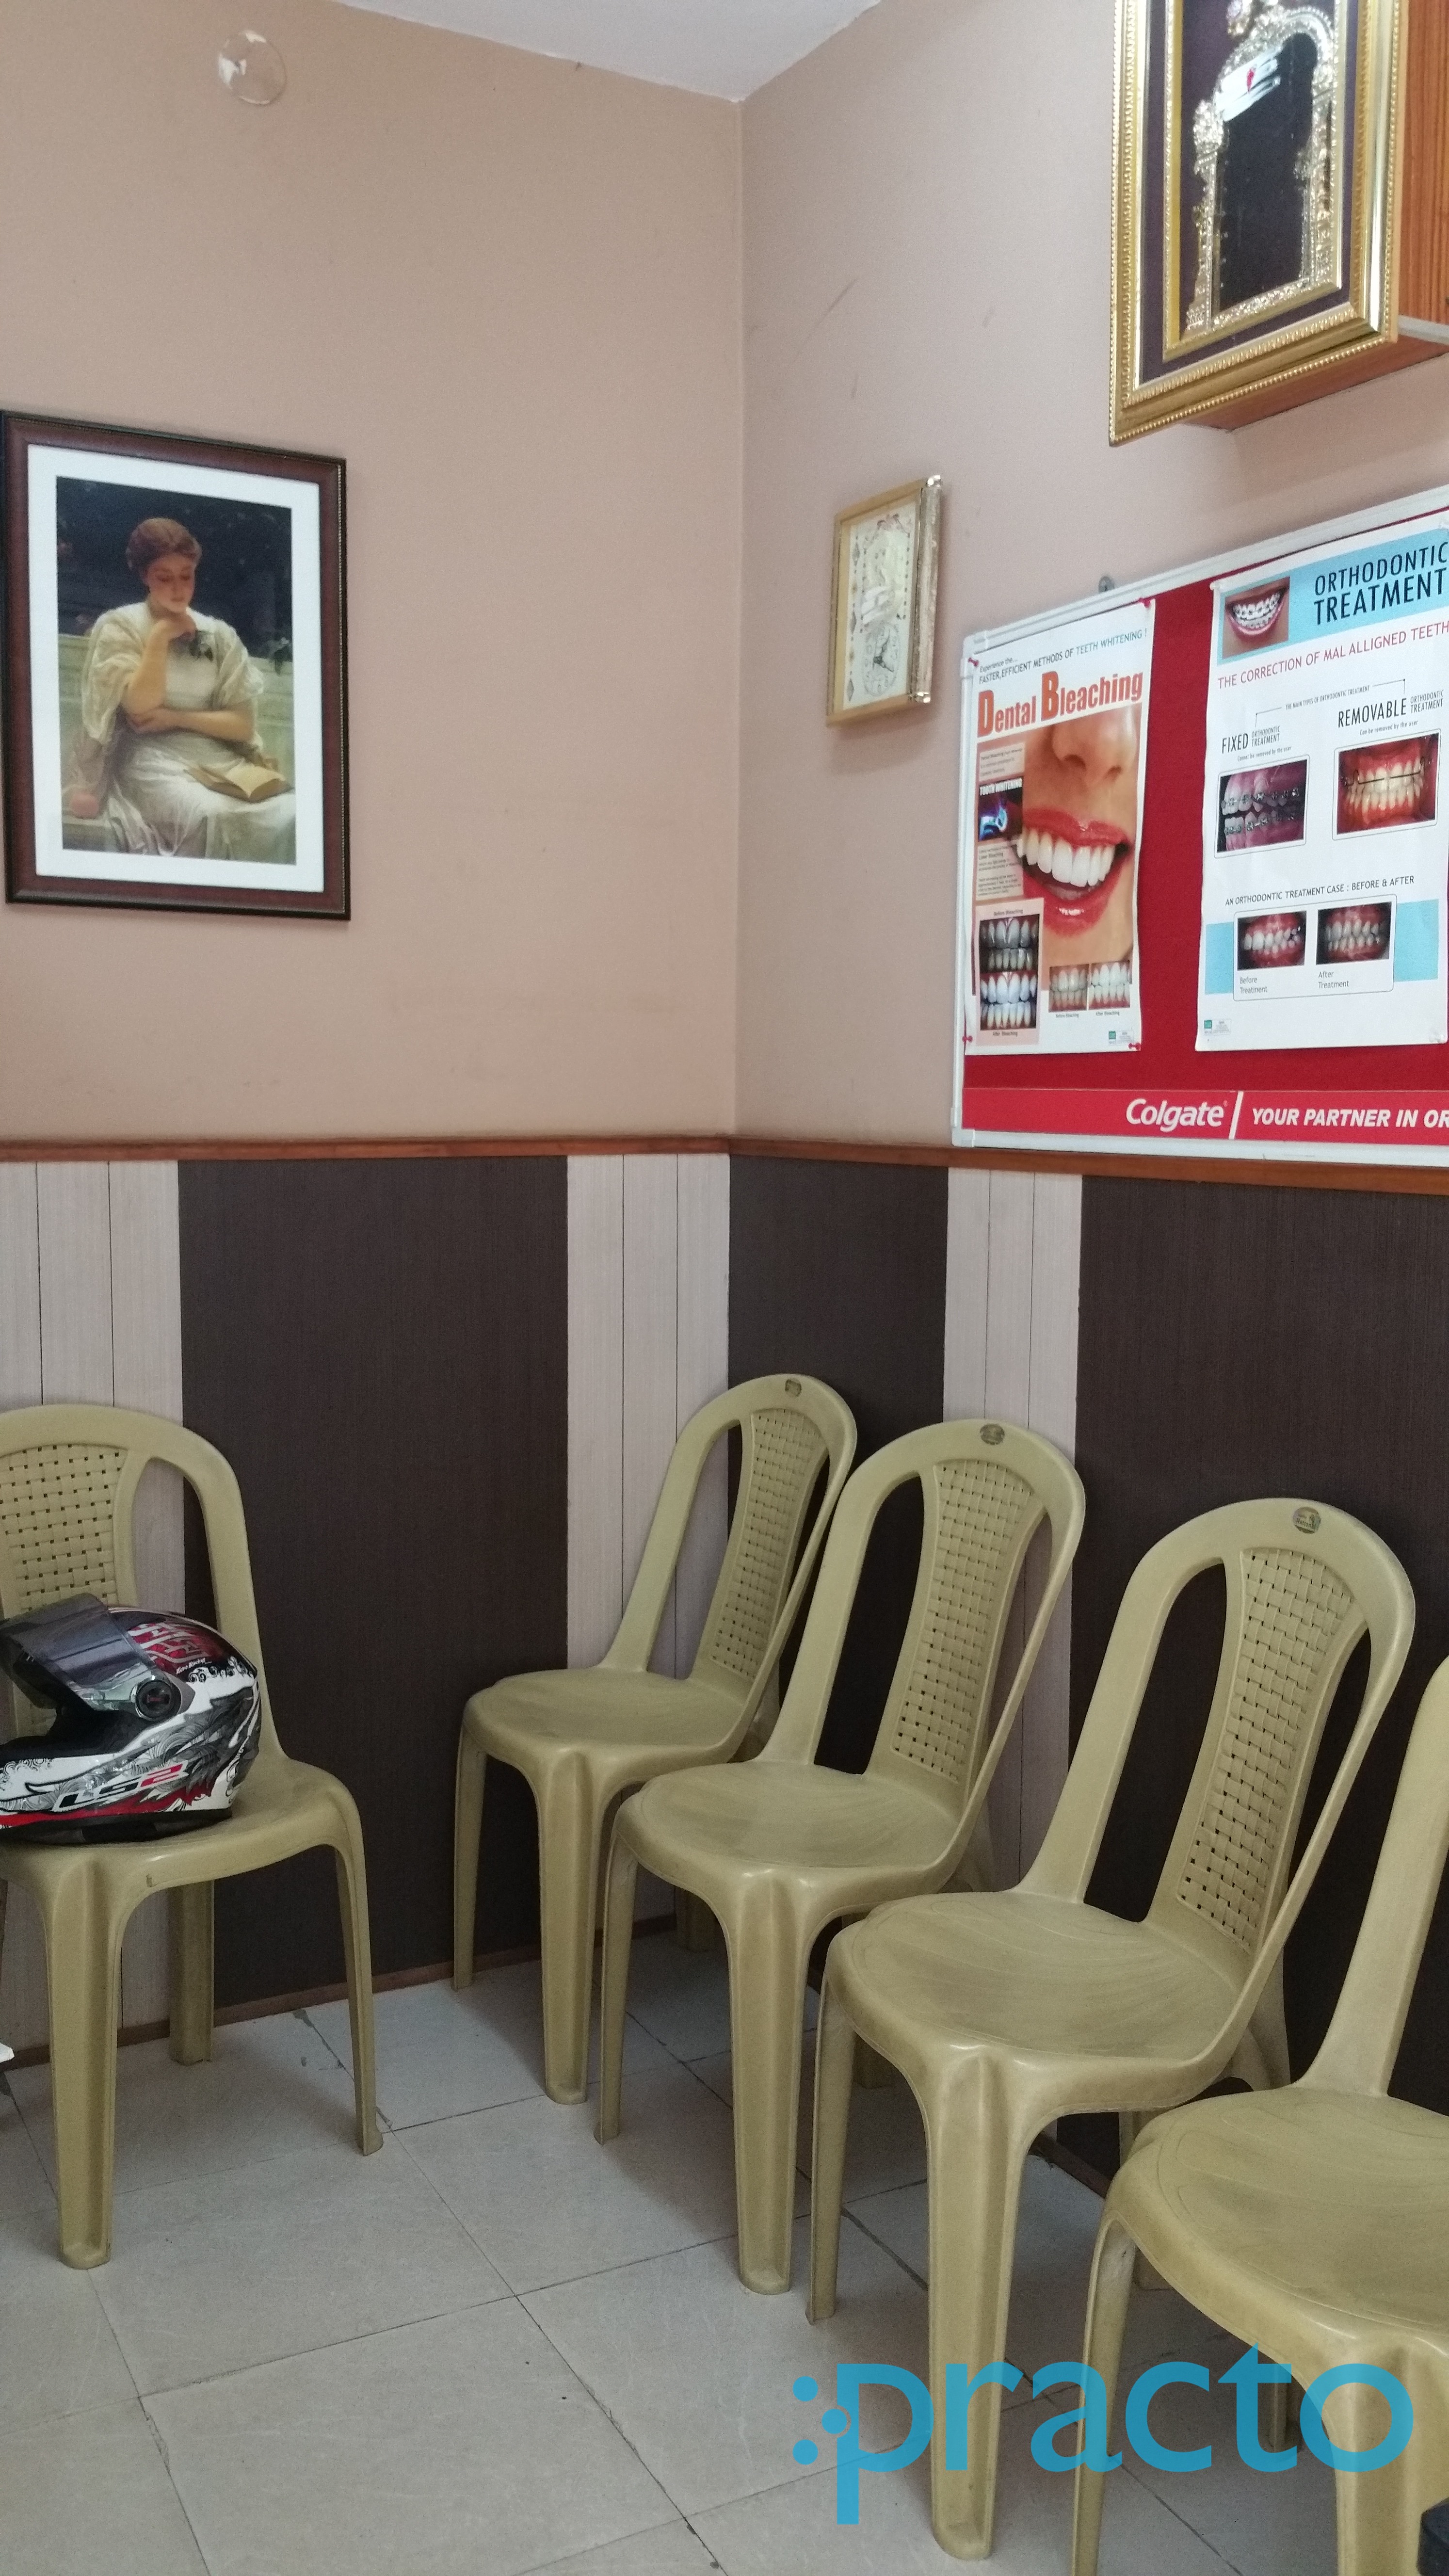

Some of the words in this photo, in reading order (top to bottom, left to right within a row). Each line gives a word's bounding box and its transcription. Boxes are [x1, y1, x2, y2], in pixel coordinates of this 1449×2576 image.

[1315, 541, 1449, 596] ORTHODONTIC
[1314, 567, 1447, 625] TREATMENT
[1033, 651, 1063, 667] METHODS
[1064, 648, 1074, 659] OF
[1076, 641, 1098, 655] TEETH
[1100, 629, 1142, 648] WHITENING
[1218, 674, 1237, 689] THE
[1240, 656, 1302, 684] CORRECTION
[1306, 651, 1320, 666] OF
[1323, 645, 1346, 661] MAL
[1349, 631, 1406, 655] ALLIGNED
[1410, 620, 1449, 641] TEETH
[980, 660, 1004, 673] Experience
[977, 689, 1036, 738] Dental
[1041, 670, 1143, 722] Bleaching
[1303, 698, 1313, 706] TYPES
[1320, 690, 1347, 702] ORTHODONTIC
[1348, 685, 1370, 695] TREATMENT
[1410, 690, 1444, 704] ORTHODONTIC
[1338, 697, 1407, 728] REMOVABLE
[1410, 698, 1444, 713] TREATMENT
[1251, 725, 1280, 738] ORTHODONTIC
[1374, 724, 1393, 733] removed
[1222, 733, 1249, 754] FIXED
[1252, 733, 1280, 747] TREATMENT
[1256, 750, 1271, 758] removed
[1225, 898, 1234, 906] AN
[1235, 891, 1283, 905] ORTHODONTIC
[1285, 886, 1325, 899] TREATMENT
[1327, 884, 1344, 894] CASE
[1352, 880, 1380, 891] BEFORE
[1382, 879, 1387, 887] &
[1389, 875, 1414, 886] AFTER
[1240, 976, 1257, 984] Before
[1318, 981, 1349, 989] Treatment
[1240, 986, 1267, 994] Treatment
[1126, 1098, 1224, 1132] Colgate
[1252, 1108, 1300, 1126] YOUR
[1303, 1108, 1391, 1127] PARTNER
[1395, 1109, 1419, 1127] IN
